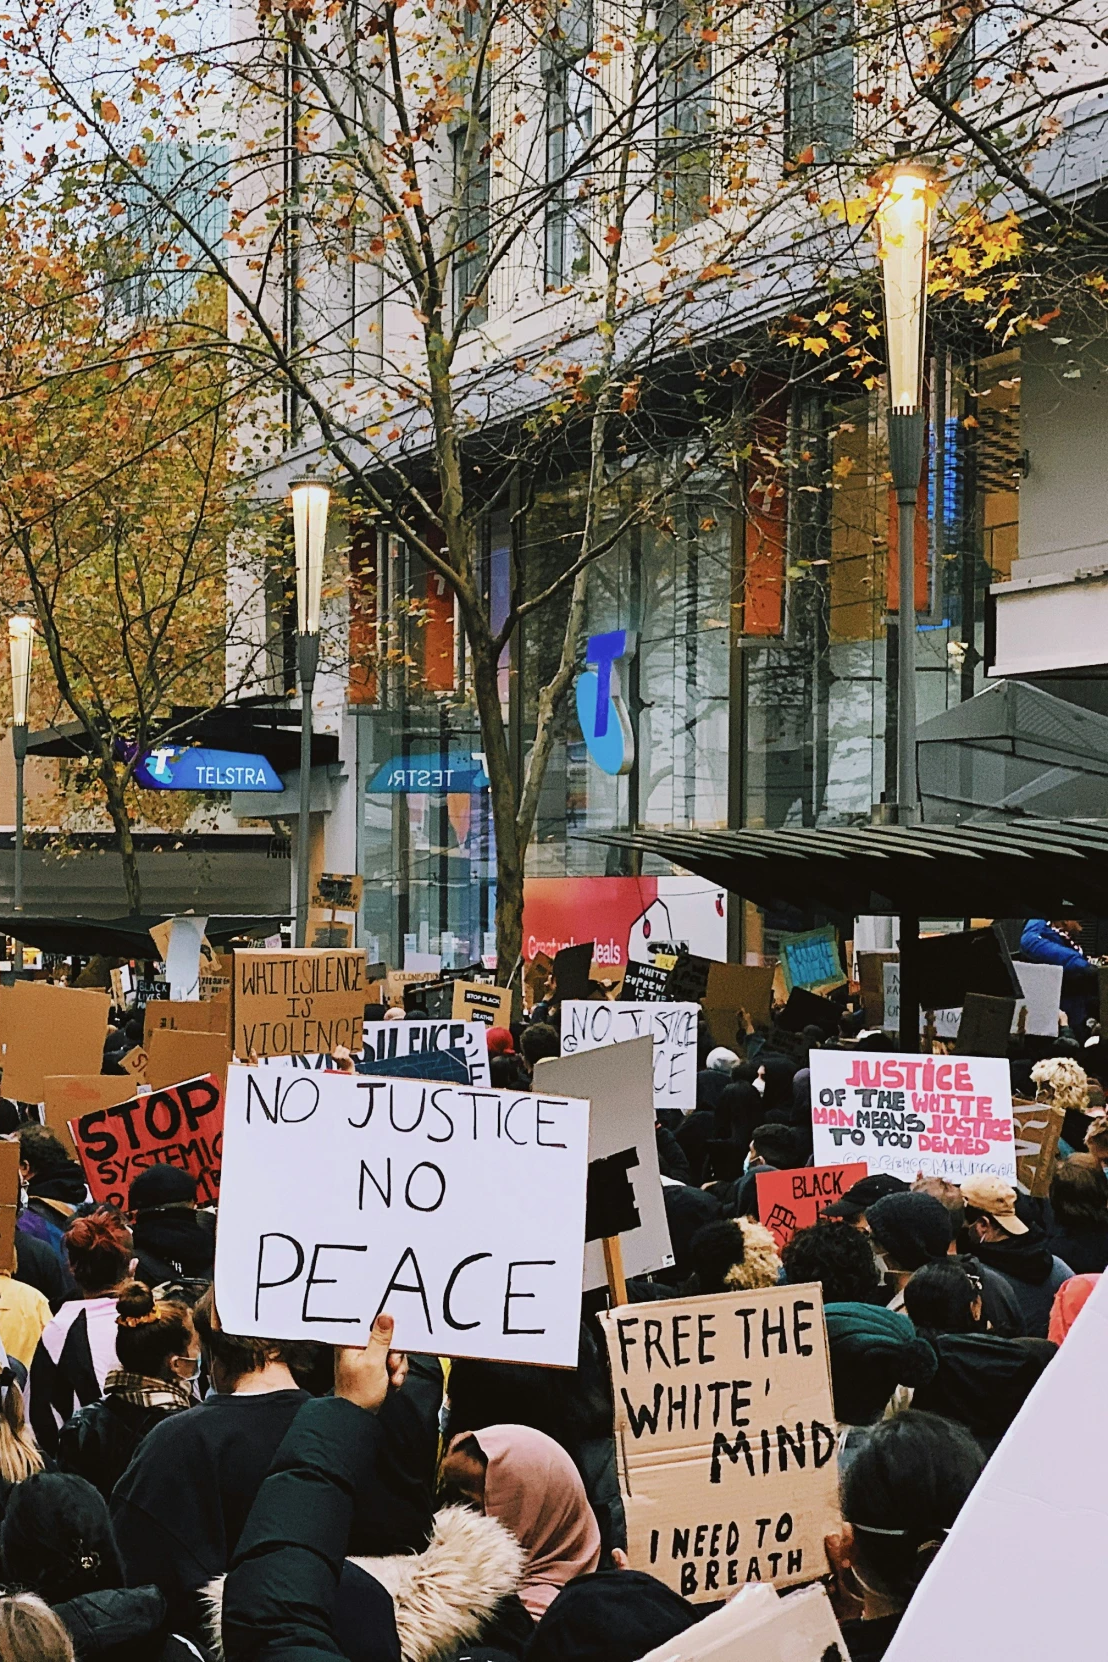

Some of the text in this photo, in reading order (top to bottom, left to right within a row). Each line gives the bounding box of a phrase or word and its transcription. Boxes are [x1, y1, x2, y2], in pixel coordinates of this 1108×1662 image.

[196, 767, 266, 784] TELSTRA
[139, 981, 167, 992] BLACK
[639, 966, 668, 981] WHITE
[138, 991, 161, 1001] LIVES
[286, 997, 313, 1018] IS
[482, 996, 501, 1005] BLACK
[635, 988, 645, 997] IS
[243, 1016, 362, 1057] VIOLENCE
[351, 1024, 465, 1063] SILENCE
[572, 1005, 698, 1047] NO JUSTICE
[653, 1050, 687, 1095] CE
[846, 1058, 974, 1092] JUSTICE
[79, 1080, 220, 1161] STOP
[247, 1074, 568, 1149] NO JUSTICE
[819, 1088, 993, 1117] OF THE WHITE
[813, 1107, 1013, 1141] MAN MEANS JUSTICE
[829, 1128, 990, 1155] TO YOU DENIED
[359, 1157, 446, 1213] NO
[792, 1171, 844, 1199] BLACK
[256, 1233, 556, 1335] PEACE
[617, 1300, 814, 1374] FREE THE
[710, 1420, 835, 1483] MIND
[650, 1512, 793, 1563] I NEED TO
[680, 1549, 803, 1596] BREATH
